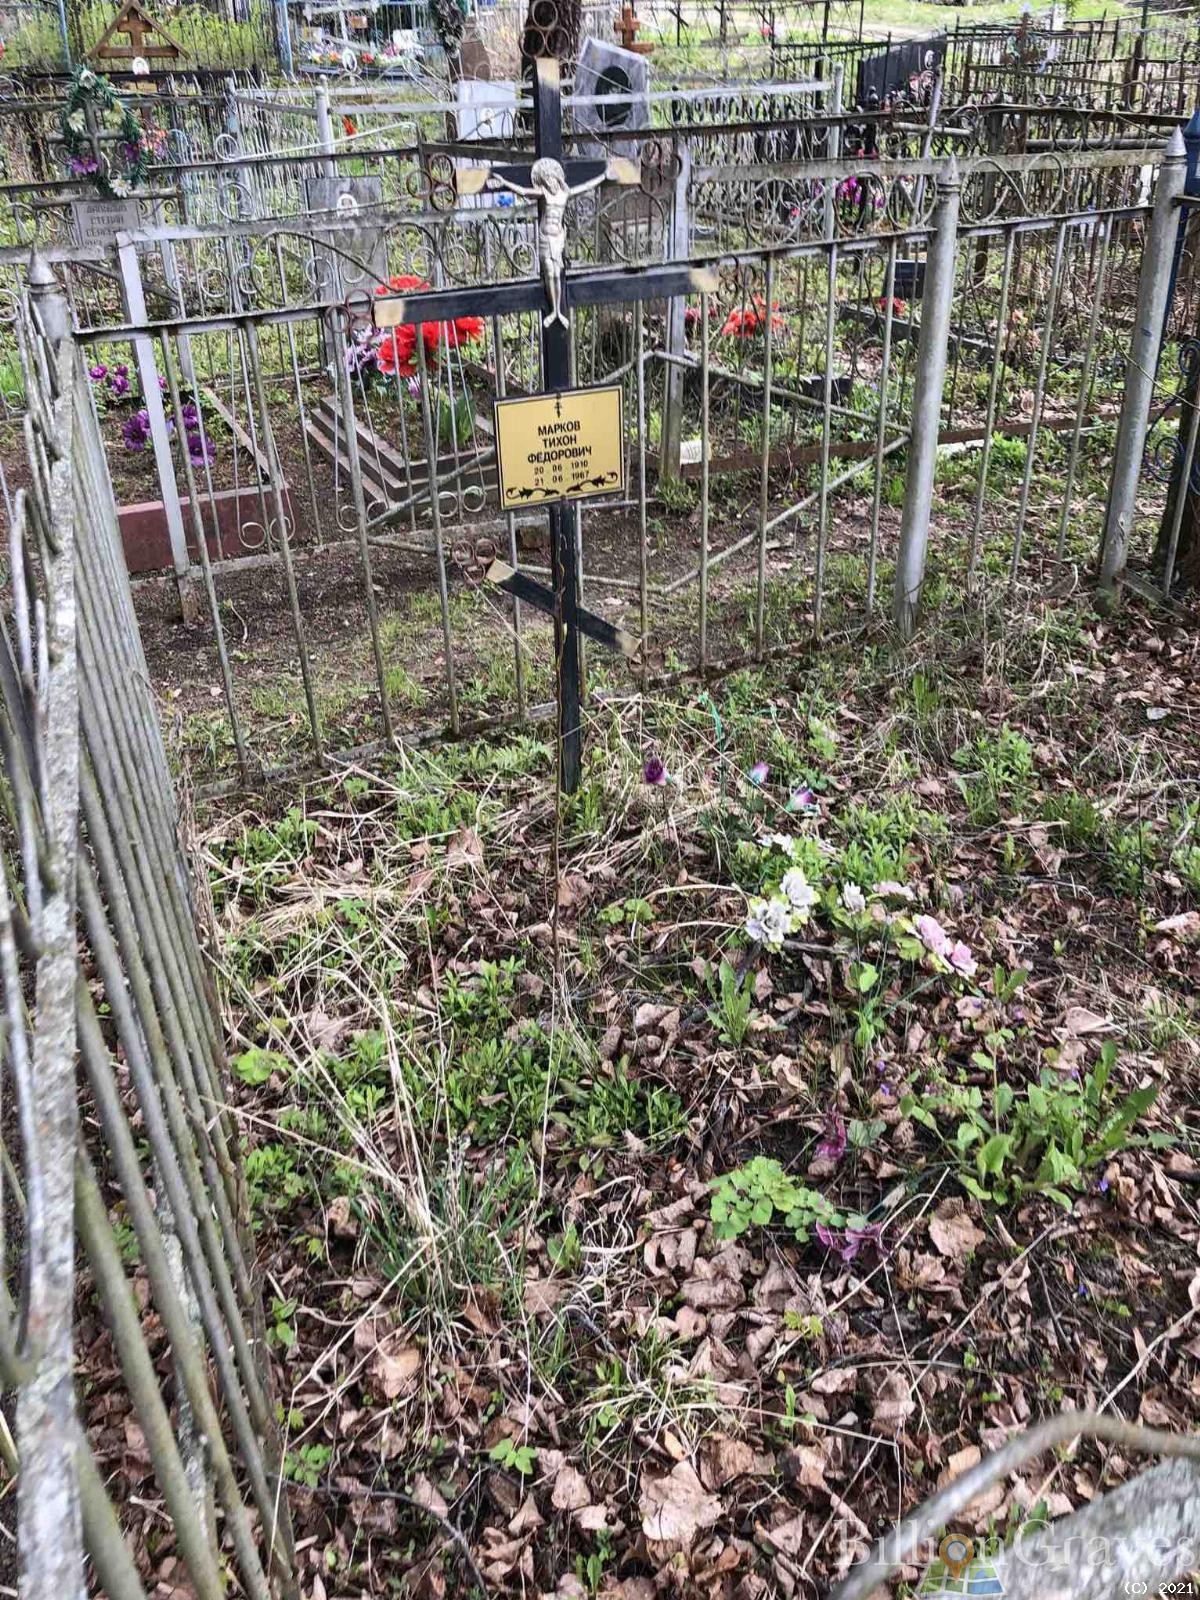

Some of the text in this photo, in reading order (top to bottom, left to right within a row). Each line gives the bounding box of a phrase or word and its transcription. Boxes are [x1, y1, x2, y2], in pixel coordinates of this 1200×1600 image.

[537, 420, 581, 437] МАРКОВ
[542, 433, 577, 449] ТИХОН
[527, 445, 592, 464] ФЕДОРОВИЧ
[534, 466, 545, 475] 20
[571, 460, 589, 470] 1910
